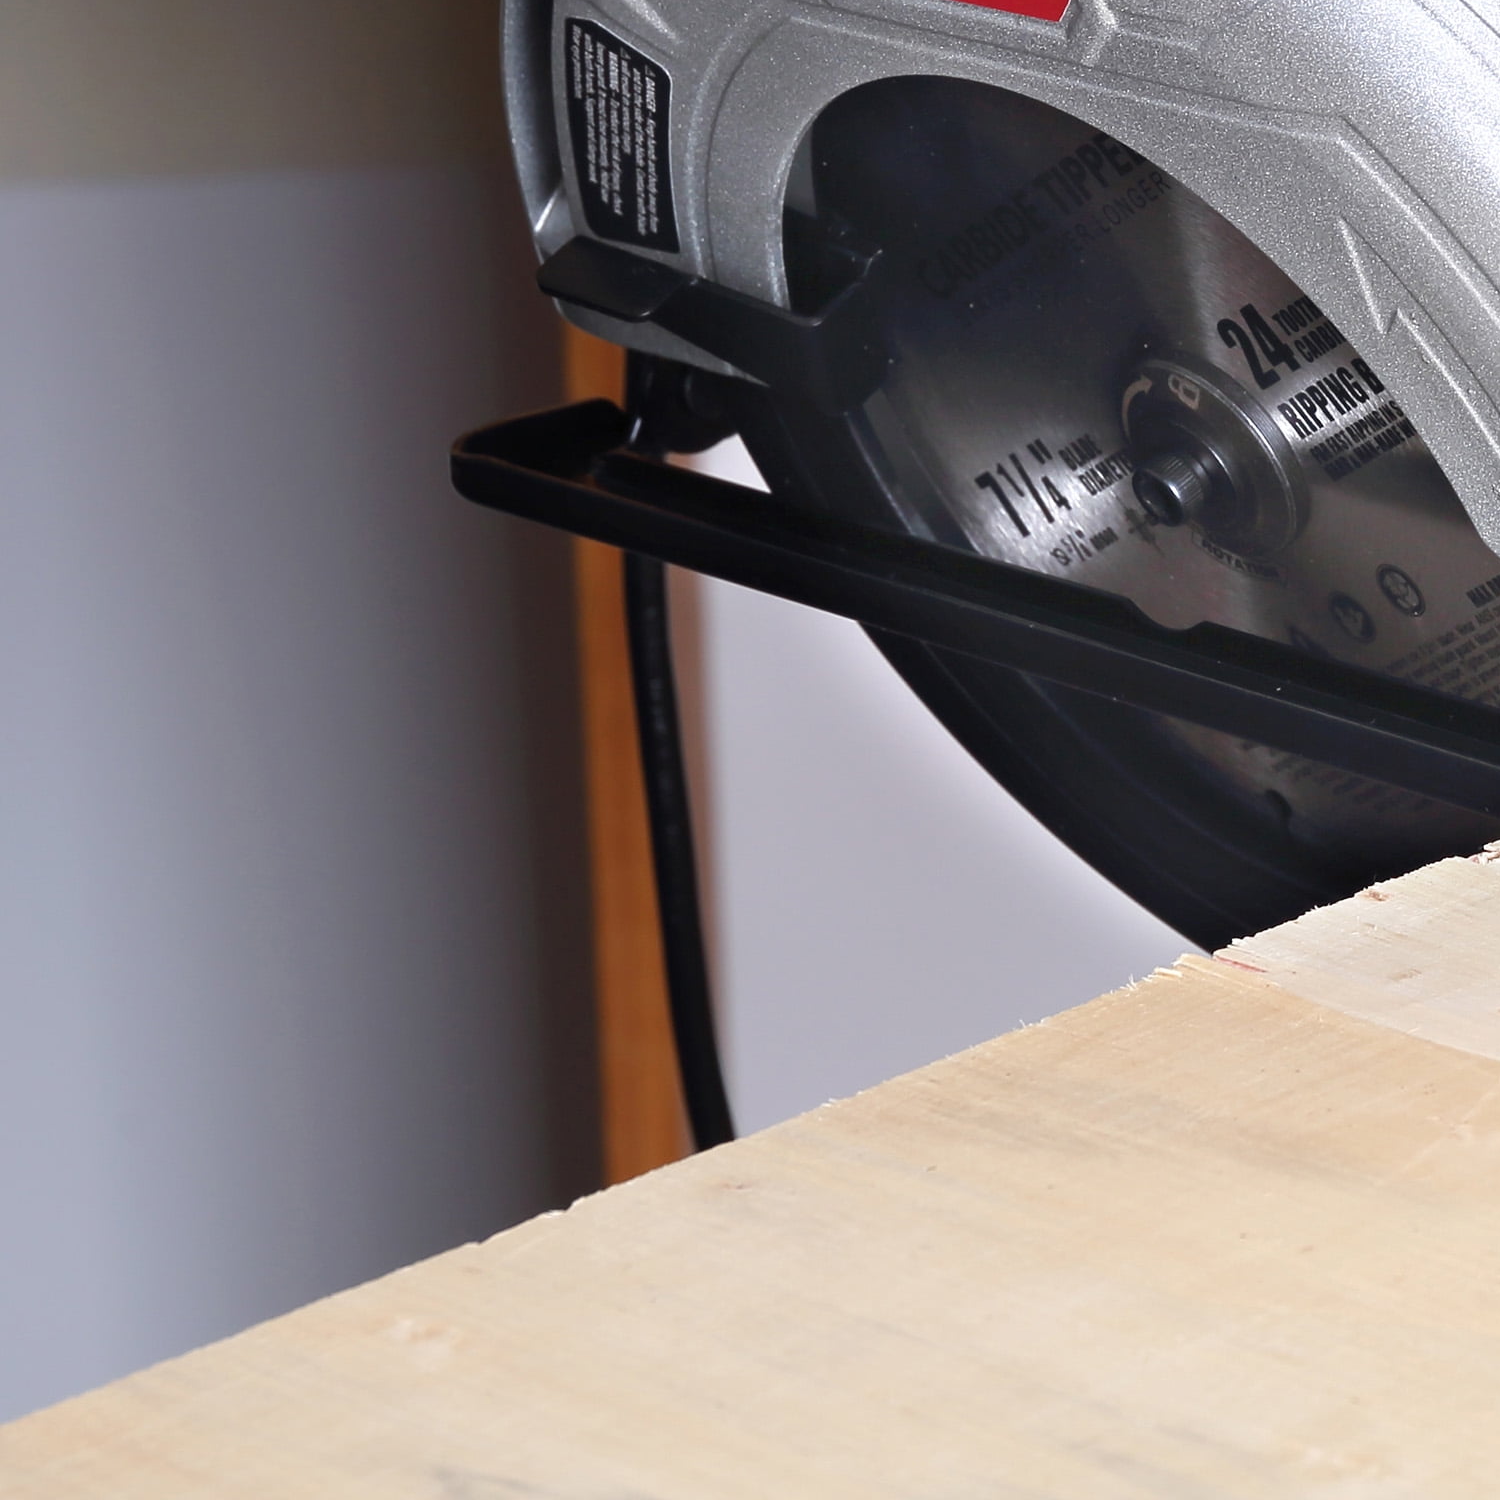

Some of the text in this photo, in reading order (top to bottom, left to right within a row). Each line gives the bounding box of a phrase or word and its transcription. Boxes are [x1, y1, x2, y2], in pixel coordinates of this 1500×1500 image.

[1098, 171, 1171, 234] LONGER
[914, 189, 1050, 299] CARBIDE
[1217, 303, 1301, 390] 24
[1277, 366, 1370, 439] RIPPING
